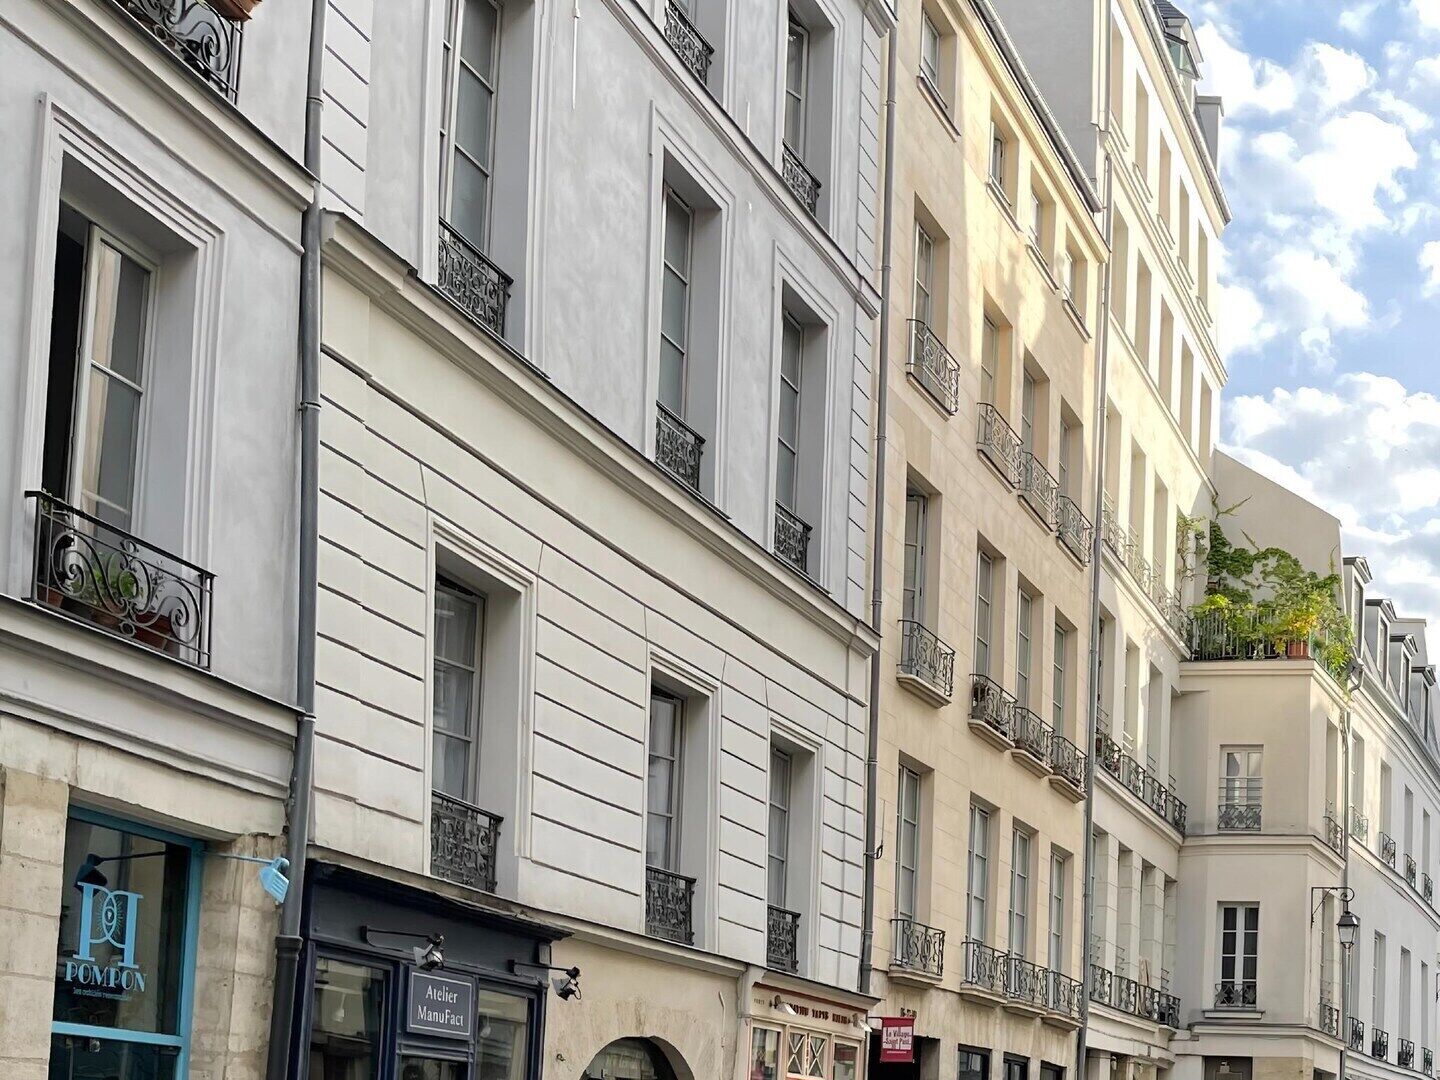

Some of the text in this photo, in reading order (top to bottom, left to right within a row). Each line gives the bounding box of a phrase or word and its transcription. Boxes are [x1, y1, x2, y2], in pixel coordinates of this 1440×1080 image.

[64, 961, 148, 992] POMPON
[425, 984, 459, 1004] Atelier
[417, 1005, 464, 1027] ManuFact
